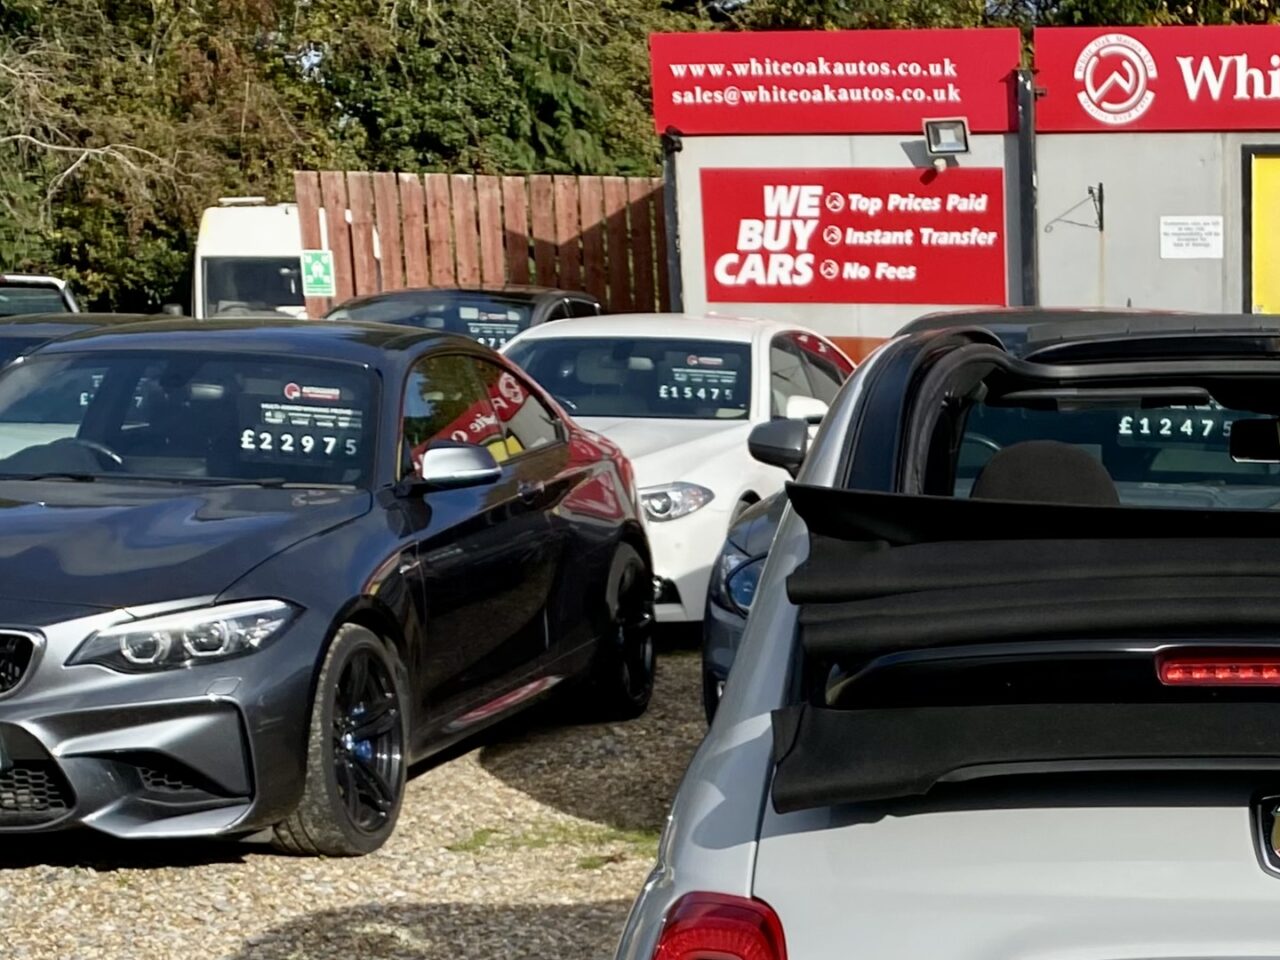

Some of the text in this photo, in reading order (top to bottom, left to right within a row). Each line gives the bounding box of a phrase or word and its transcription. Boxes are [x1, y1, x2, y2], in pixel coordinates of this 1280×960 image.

[670, 57, 957, 79] www.whiteoakautos.co.uk
[672, 83, 961, 106] sales@whiteoakautos.co.uk
[763, 185, 824, 218] WE
[848, 194, 988, 216] Top Prices Paid
[737, 219, 821, 252] BUY
[845, 228, 997, 247] Instant Transfer
[714, 253, 815, 286] CARS
[842, 263, 917, 280] No Fees
[659, 385, 733, 401] £15475
[1118, 416, 1233, 437] £12475
[241, 429, 357, 455] £22975
